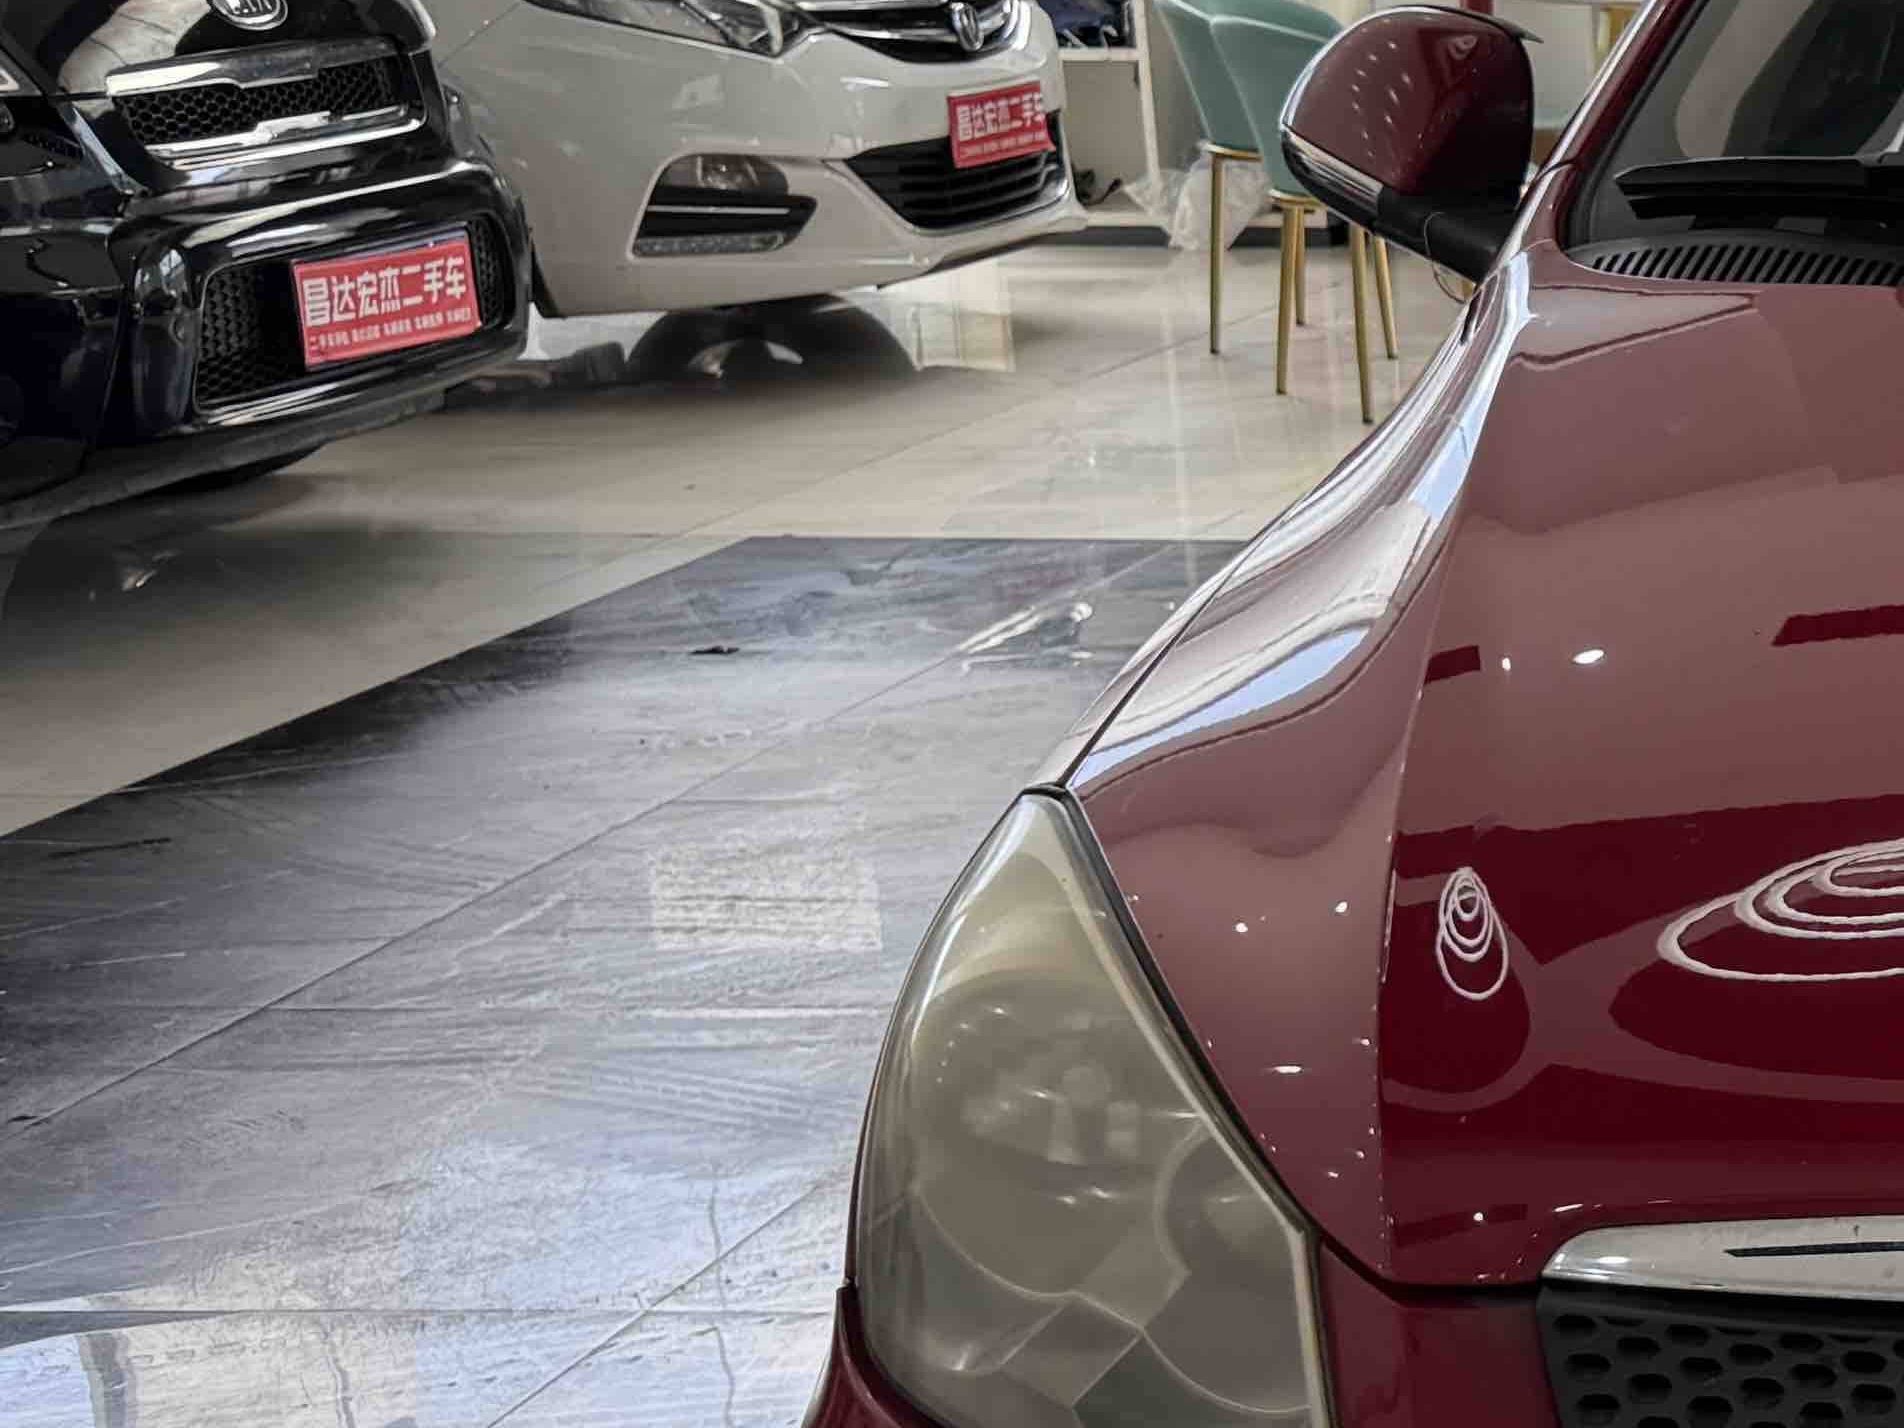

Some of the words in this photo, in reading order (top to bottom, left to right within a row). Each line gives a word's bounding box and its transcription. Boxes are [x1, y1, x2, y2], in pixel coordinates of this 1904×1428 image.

[302, 256, 467, 327] 昌达宏杰二手车
